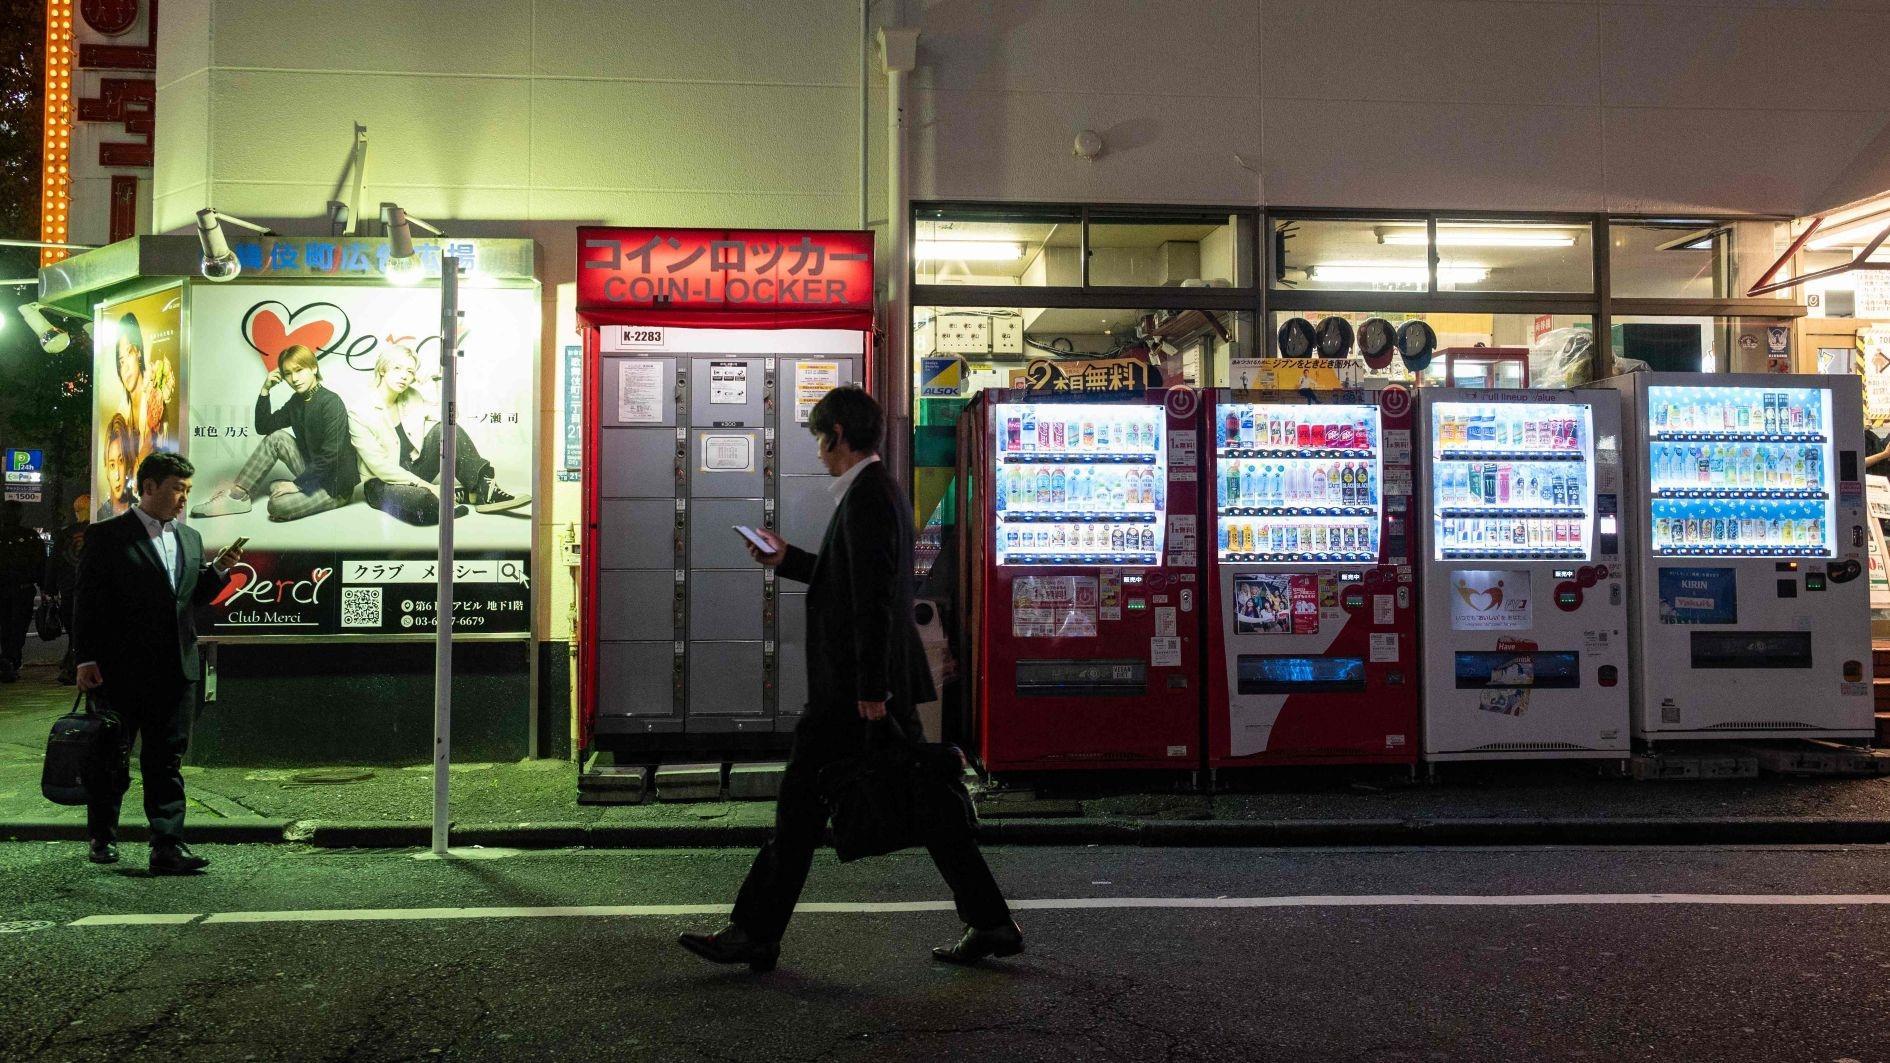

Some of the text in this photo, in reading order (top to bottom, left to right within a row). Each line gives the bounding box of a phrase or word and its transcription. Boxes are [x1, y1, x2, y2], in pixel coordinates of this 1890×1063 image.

[585, 235, 868, 276] コインロッカー
[604, 276, 849, 304] COIN-LOCKER
[623, 331, 661, 342] K-2283
[923, 387, 959, 395] ALSOK
[1501, 393, 1527, 402] lineup
[467, 412, 519, 424] 一ノ瀬 司
[194, 426, 249, 438] 虹色 乃天
[354, 563, 488, 580] クラブ メシー
[1681, 580, 1708, 589] KIRIN
[487, 600, 523, 611] 地下1階
[228, 611, 301, 623] Club Merci
[415, 616, 485, 626] 03-67-6679
[1499, 643, 1516, 651] Have
